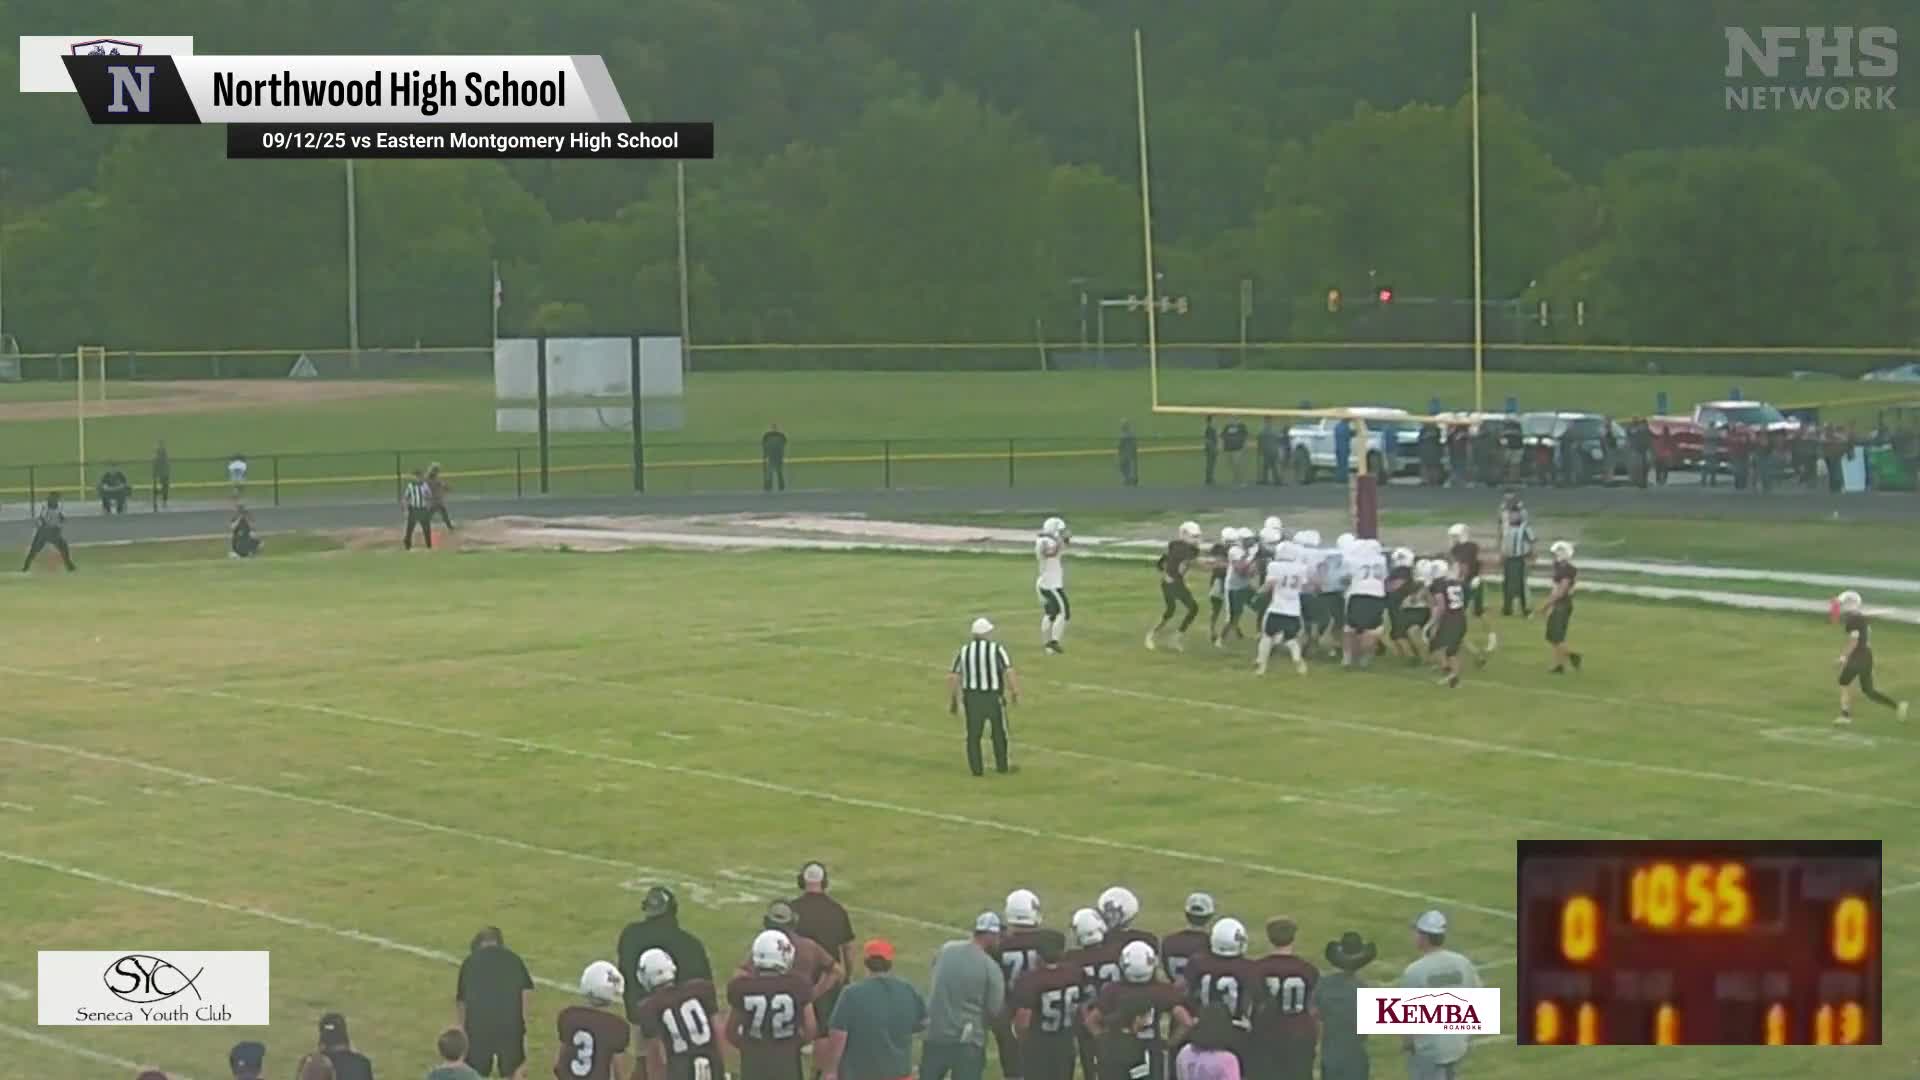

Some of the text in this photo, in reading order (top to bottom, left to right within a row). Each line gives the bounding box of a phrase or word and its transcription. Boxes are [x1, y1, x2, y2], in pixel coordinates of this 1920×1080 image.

[1562, 896, 1598, 960] 0
[1834, 897, 1869, 960] 0
[661, 998, 712, 1053] 10
[743, 994, 795, 1039] 72
[571, 1030, 594, 1076] 3
